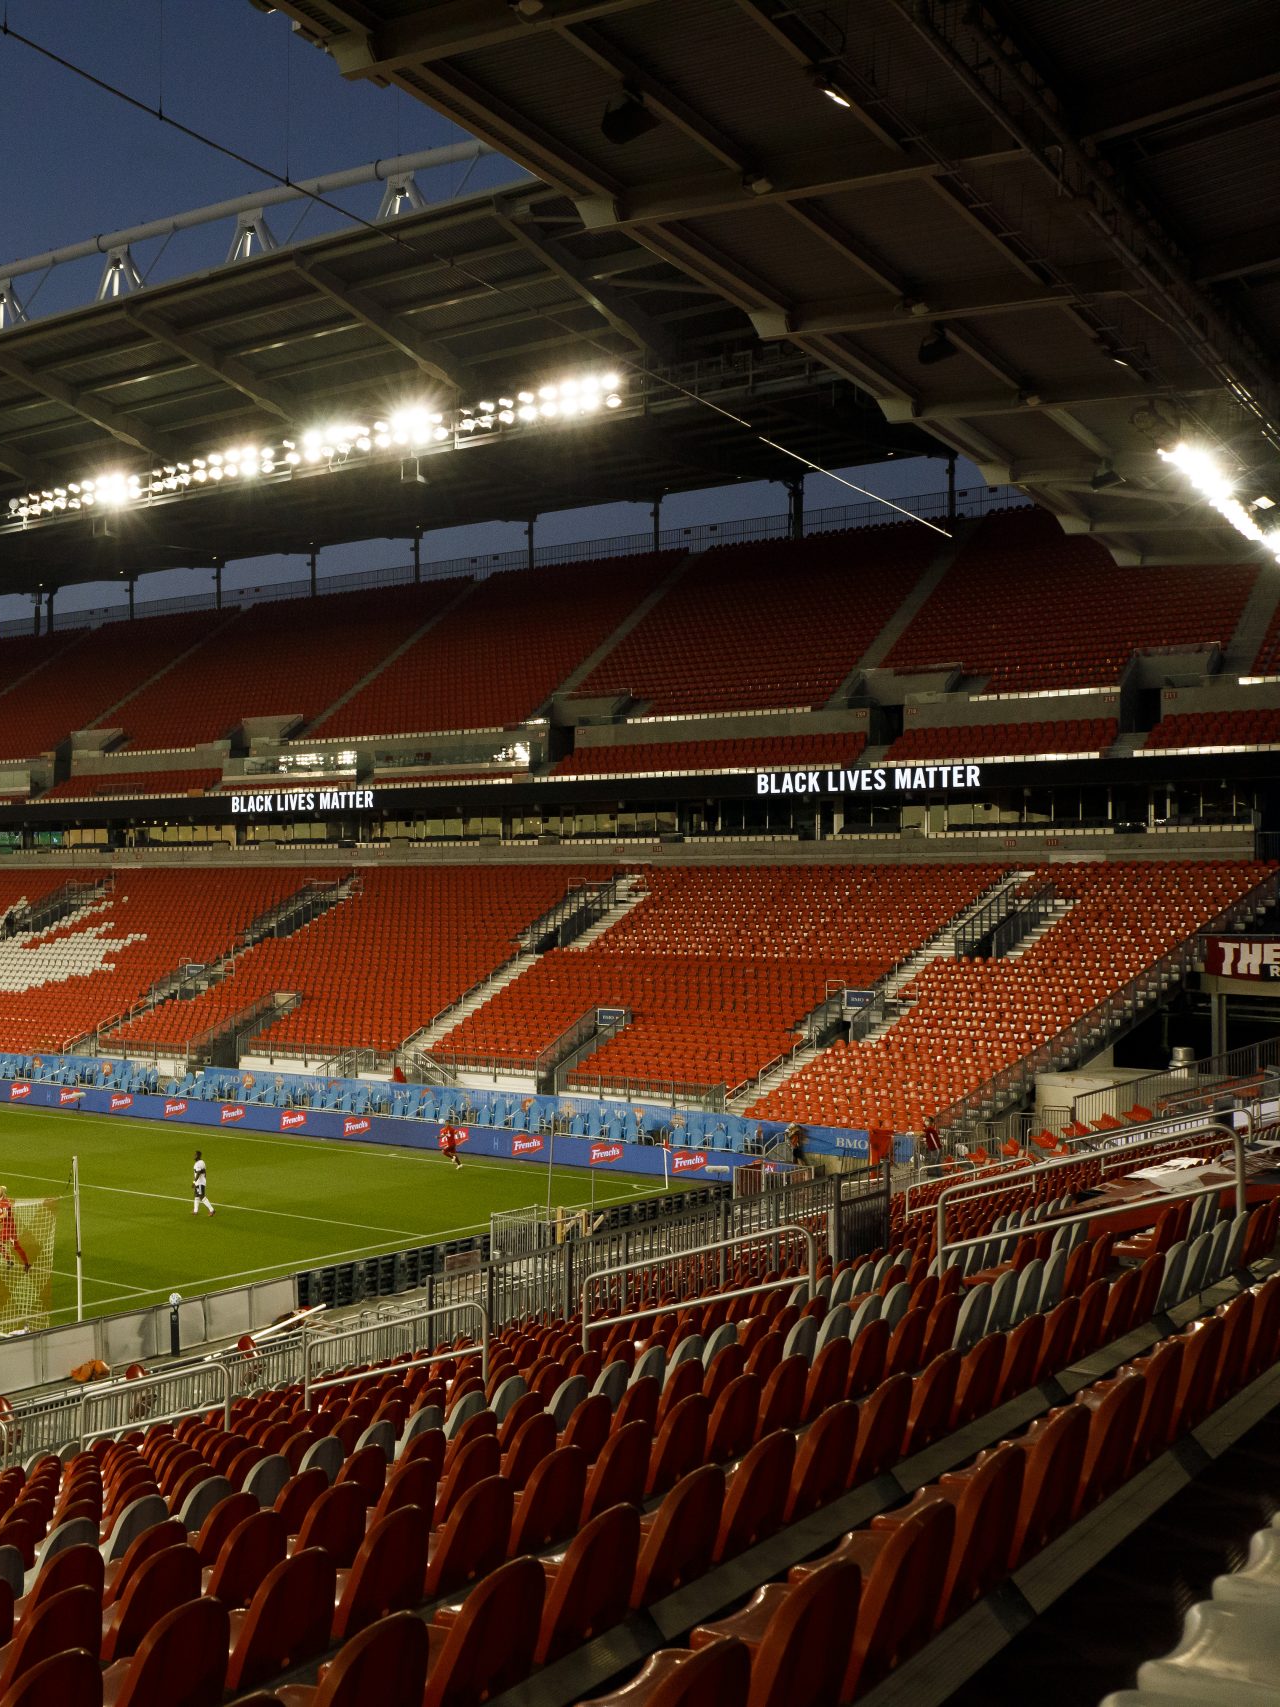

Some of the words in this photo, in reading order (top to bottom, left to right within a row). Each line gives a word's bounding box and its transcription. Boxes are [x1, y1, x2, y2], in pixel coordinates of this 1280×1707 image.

[757, 771, 821, 795] BLACK
[827, 769, 886, 792] LIVES
[894, 765, 981, 790] MATTER
[231, 795, 273, 813] BLACK
[276, 793, 315, 811] LIVES
[319, 790, 374, 809] MATTER
[1218, 942, 1280, 975] THE
[112, 1096, 131, 1108] French's
[166, 1102, 186, 1114] French's
[222, 1108, 243, 1120] French's
[282, 1114, 304, 1127] French's
[344, 1120, 368, 1133] French's
[514, 1138, 541, 1151] French's
[835, 1137, 869, 1149] BMO
[592, 1145, 620, 1160] French's
[674, 1156, 705, 1169] French's
